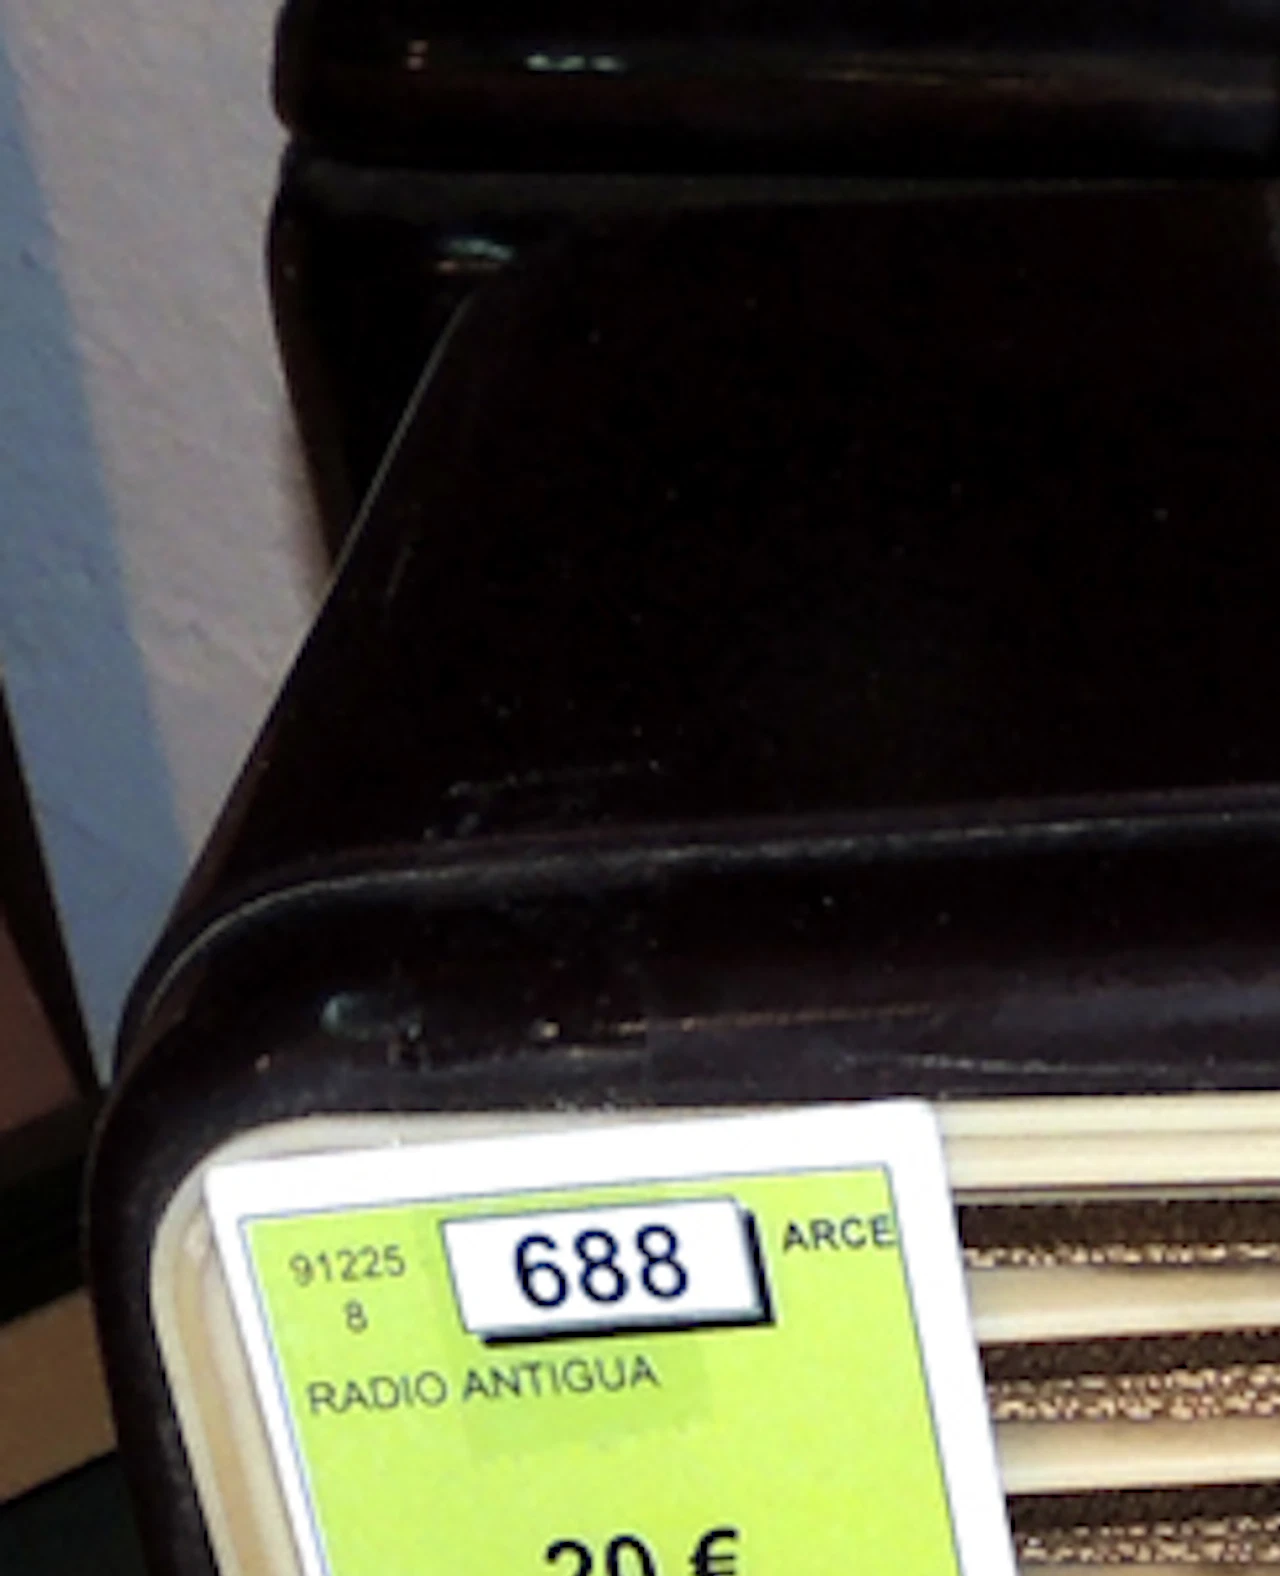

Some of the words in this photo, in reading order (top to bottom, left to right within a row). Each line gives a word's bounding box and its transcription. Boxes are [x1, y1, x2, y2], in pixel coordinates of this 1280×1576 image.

[783, 1213, 897, 1255] ARCE
[289, 1243, 407, 1287] 91225
[513, 1223, 691, 1311] 688
[345, 1297, 369, 1334] 8
[306, 1368, 448, 1416] RADIO
[461, 1354, 659, 1402] ANTIGUA
